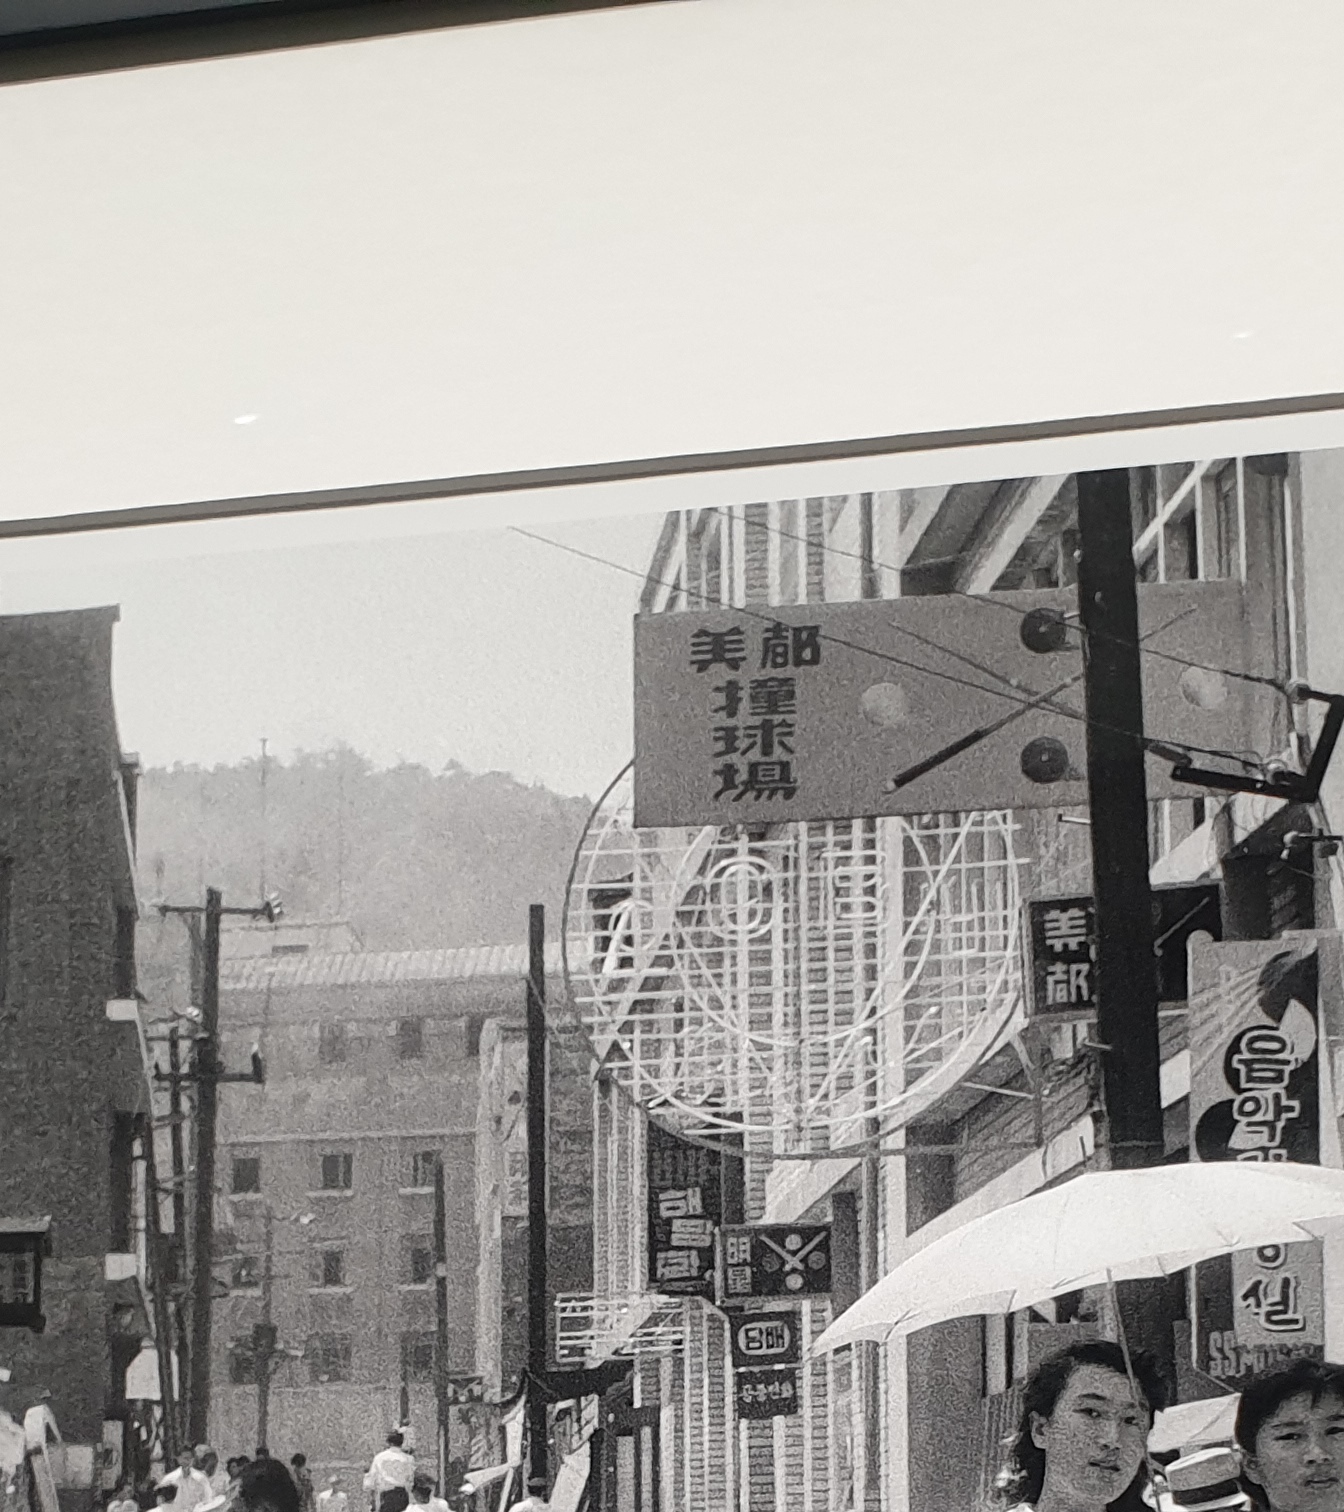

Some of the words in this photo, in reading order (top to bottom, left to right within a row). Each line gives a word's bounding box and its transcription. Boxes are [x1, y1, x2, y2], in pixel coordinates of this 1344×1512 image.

[689, 622, 822, 674] 美都
[712, 677, 798, 802] 撞球場
